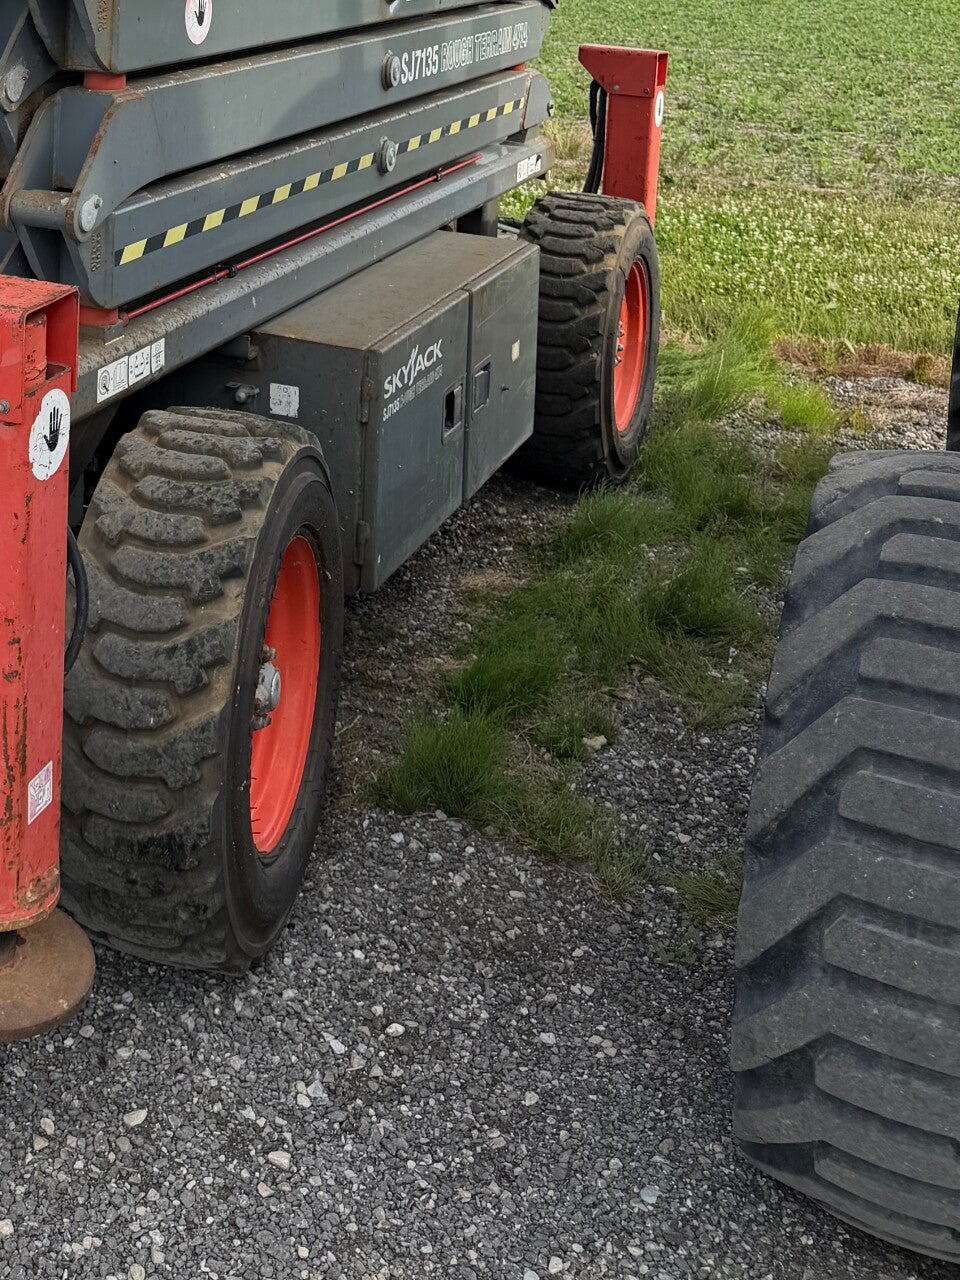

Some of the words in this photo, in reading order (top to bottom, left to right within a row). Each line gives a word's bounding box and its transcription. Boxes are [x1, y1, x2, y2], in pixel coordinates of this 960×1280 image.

[401, 45, 439, 85] SJ7135
[440, 35, 474, 73] ROUGH
[475, 25, 513, 62] TERRAIN
[383, 338, 443, 400] SKYJACK
